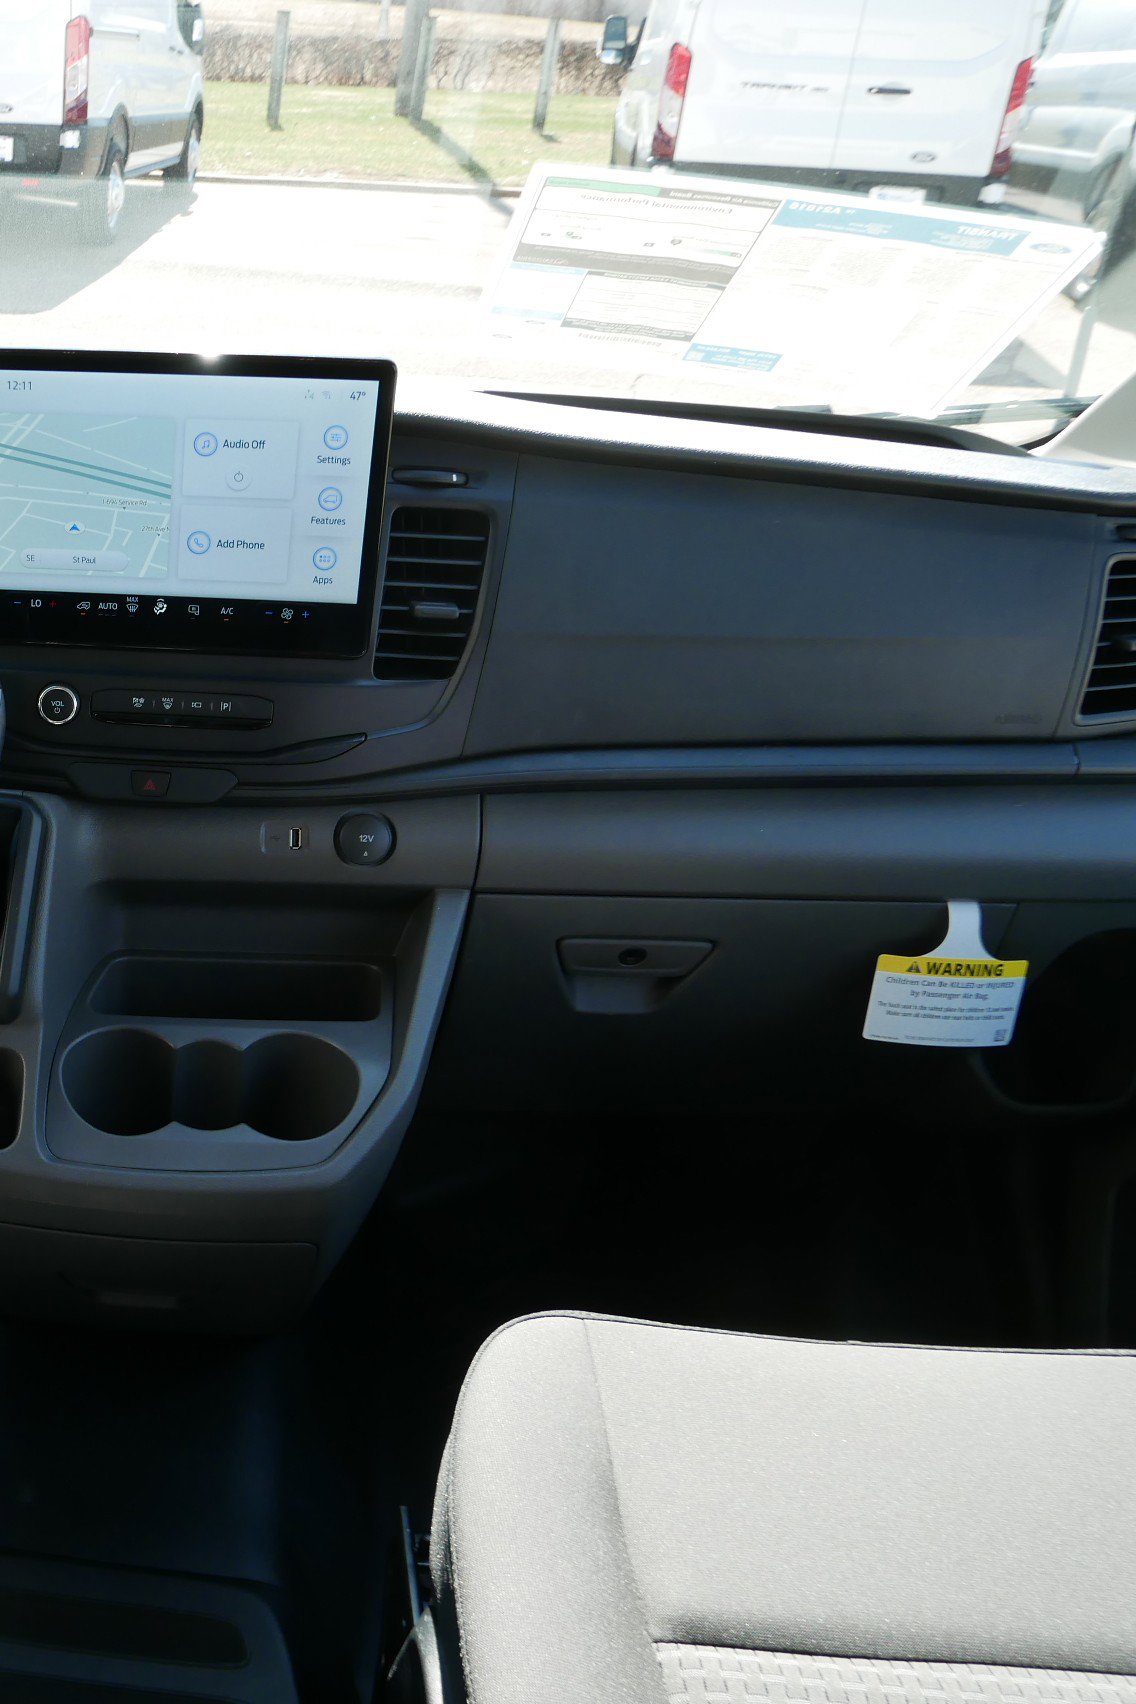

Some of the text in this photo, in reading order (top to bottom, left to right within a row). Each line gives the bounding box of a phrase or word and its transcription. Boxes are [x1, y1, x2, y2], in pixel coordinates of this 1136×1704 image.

[7, 380, 32, 391] 12:11
[222, 439, 266, 449] Audio Off
[317, 455, 351, 466] Settings
[310, 516, 346, 526] Features
[216, 539, 265, 550] Add Phone
[81, 556, 96, 564] Paul
[312, 576, 333, 585] Apps
[30, 599, 42, 608] LO
[98, 602, 118, 610] AUTO
[220, 607, 234, 615] A/C
[358, 834, 375, 842] 12V
[926, 961, 1004, 977] WARNING
[885, 976, 919, 986] Children
[921, 978, 936, 987] Can
